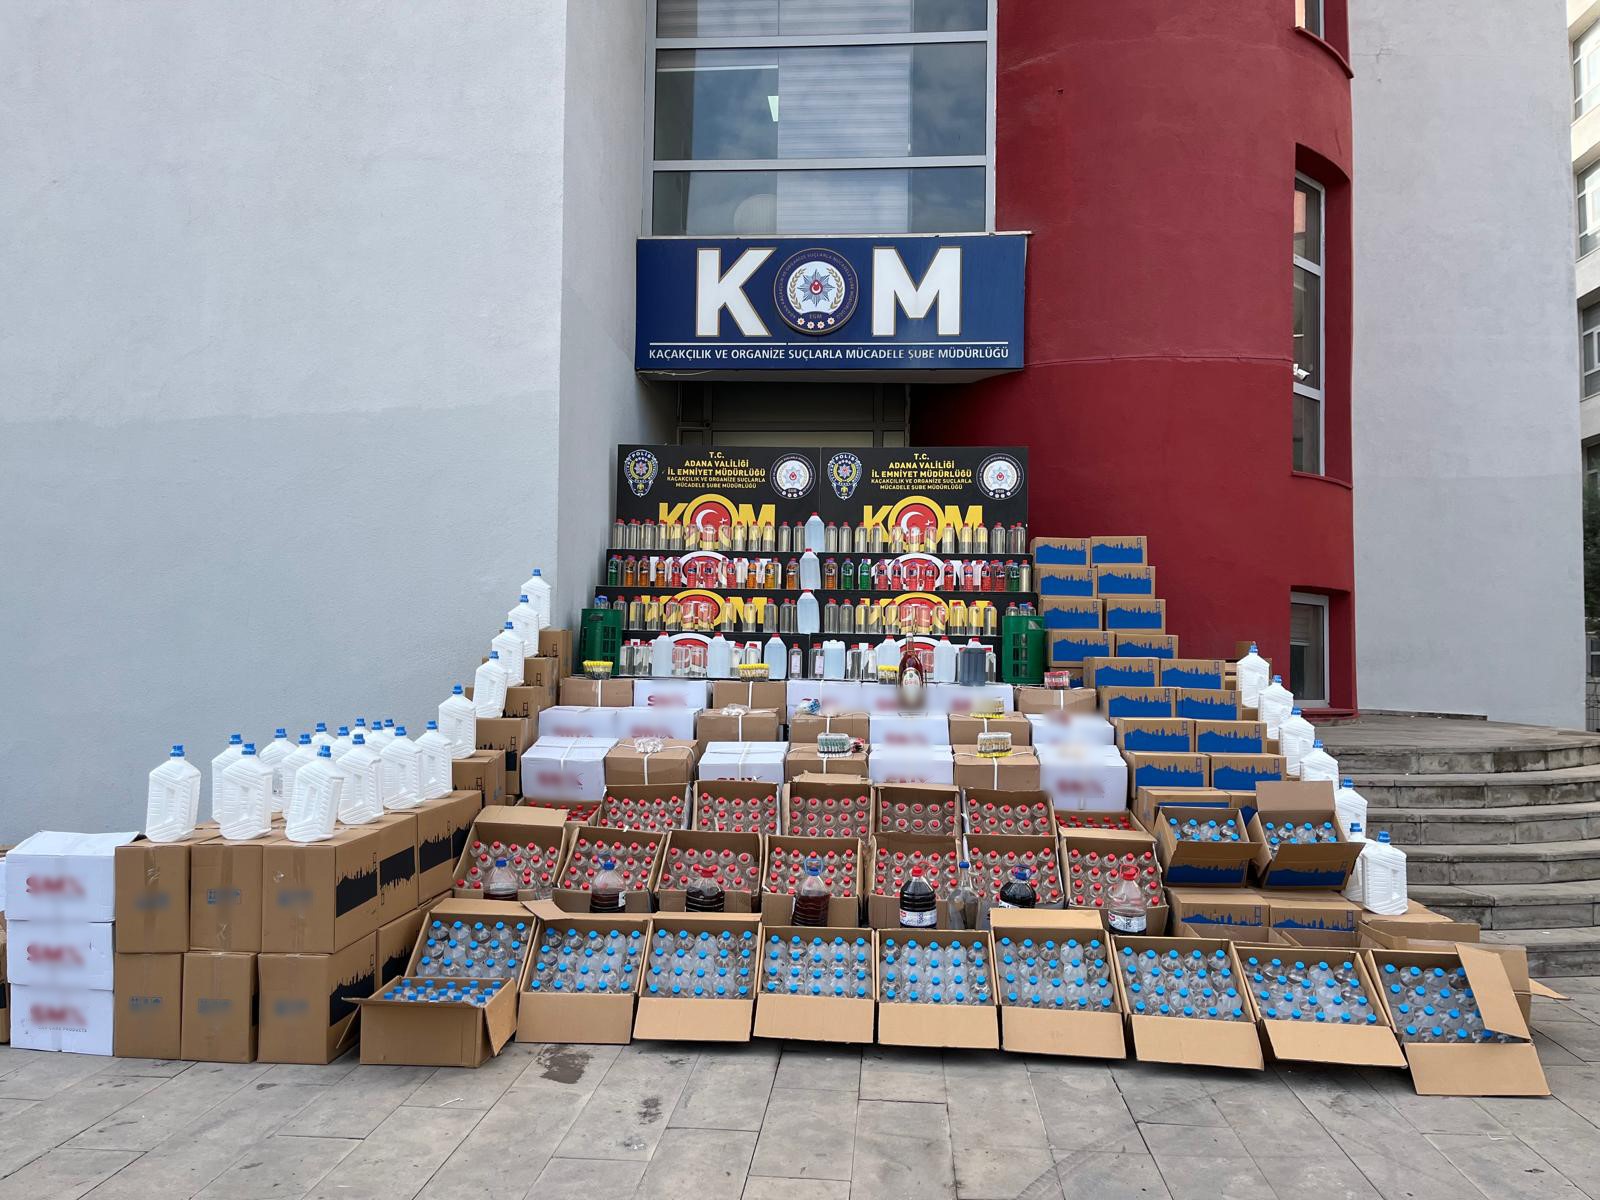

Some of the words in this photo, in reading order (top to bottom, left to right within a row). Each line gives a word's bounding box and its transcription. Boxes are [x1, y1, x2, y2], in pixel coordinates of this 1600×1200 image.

[649, 349, 712, 361] KAÇAKÇILIK
[715, 349, 728, 359] VE
[731, 347, 785, 359] ORGANİZE
[788, 349, 843, 361] SUÇLARLA
[846, 347, 904, 359] MÜCADELE
[908, 349, 934, 360] ŞUBE
[938, 346, 1009, 359] MÜDÜRLÜĞÜ
[709, 451, 725, 459] T.C.
[684, 460, 713, 468] ADANA
[714, 459, 749, 468] VALİLİĞİ
[919, 460, 955, 469] VALİLİĞİ
[667, 467, 676, 475] İL
[677, 467, 713, 476] EMNİYET
[715, 467, 766, 477] MÜDÜRLÜĞÜ
[871, 469, 880, 478] İL
[881, 469, 918, 478] EMNİYET
[920, 468, 972, 478] MÜDÜRLÜĞÜ
